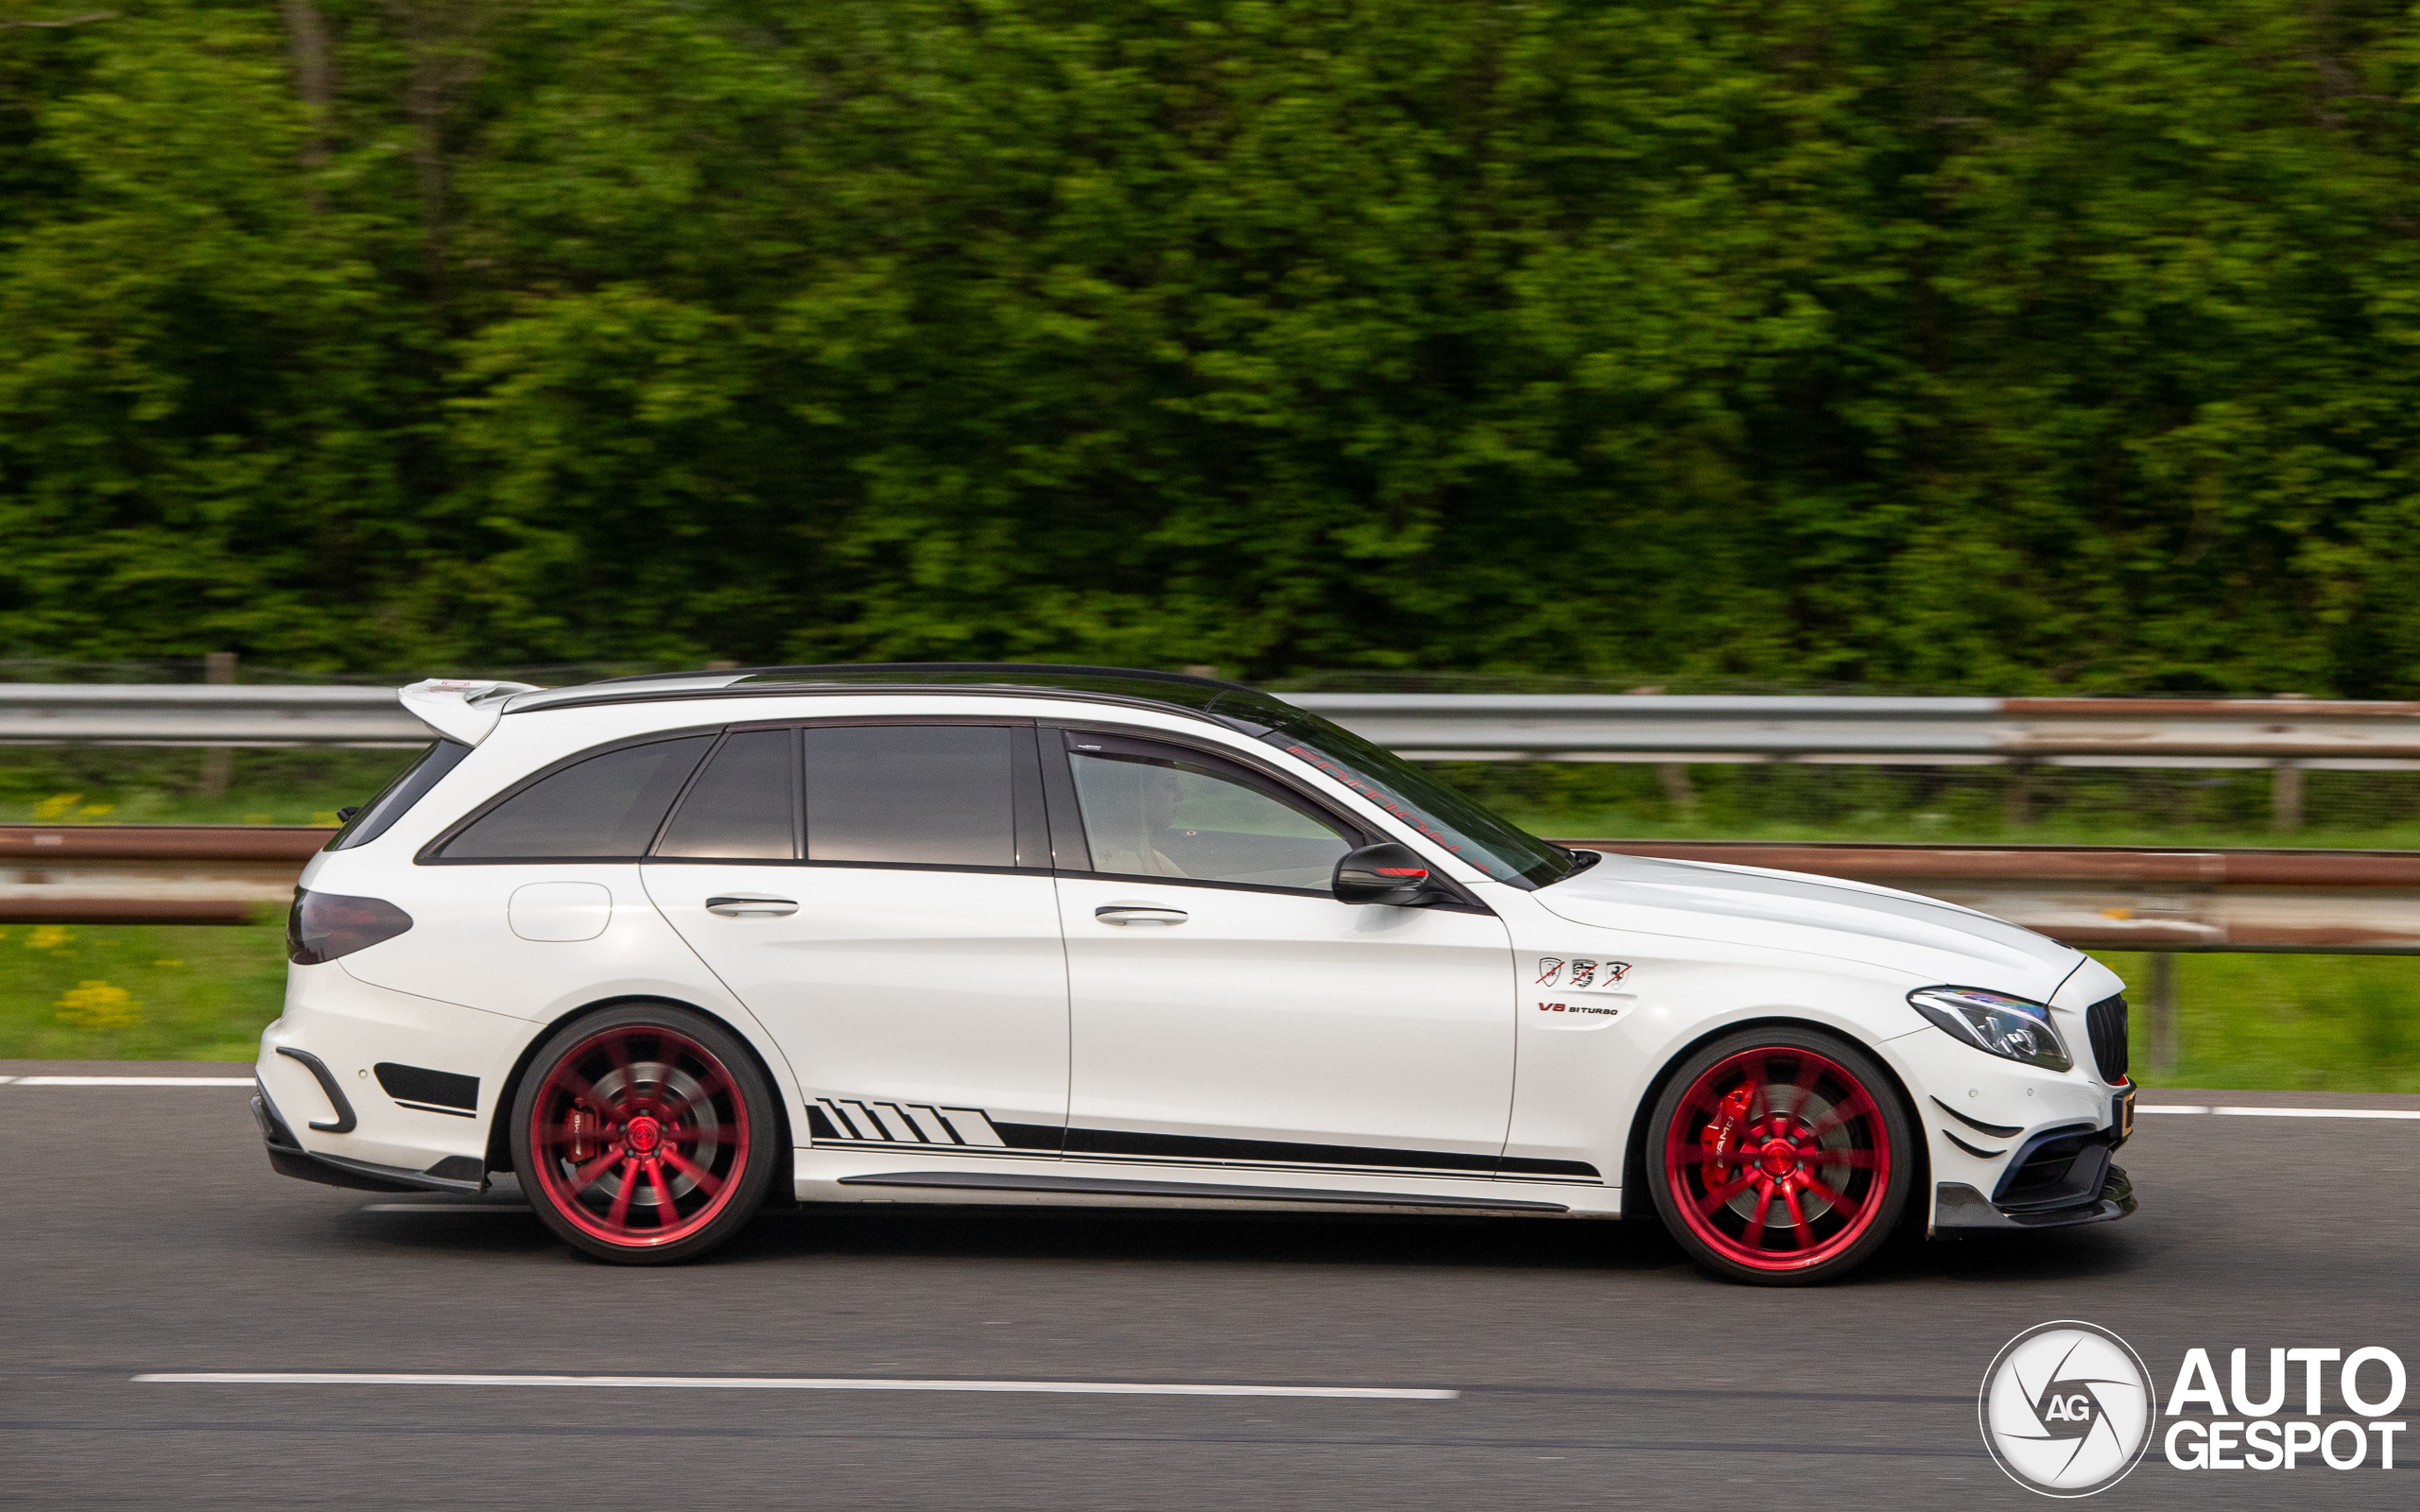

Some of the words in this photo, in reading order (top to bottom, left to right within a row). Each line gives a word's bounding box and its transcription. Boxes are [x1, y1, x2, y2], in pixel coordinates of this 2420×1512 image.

[1286, 745, 1461, 852] EDITION
[1538, 1003, 1565, 1012] V8
[1569, 1006, 1617, 1015] BITURBO
